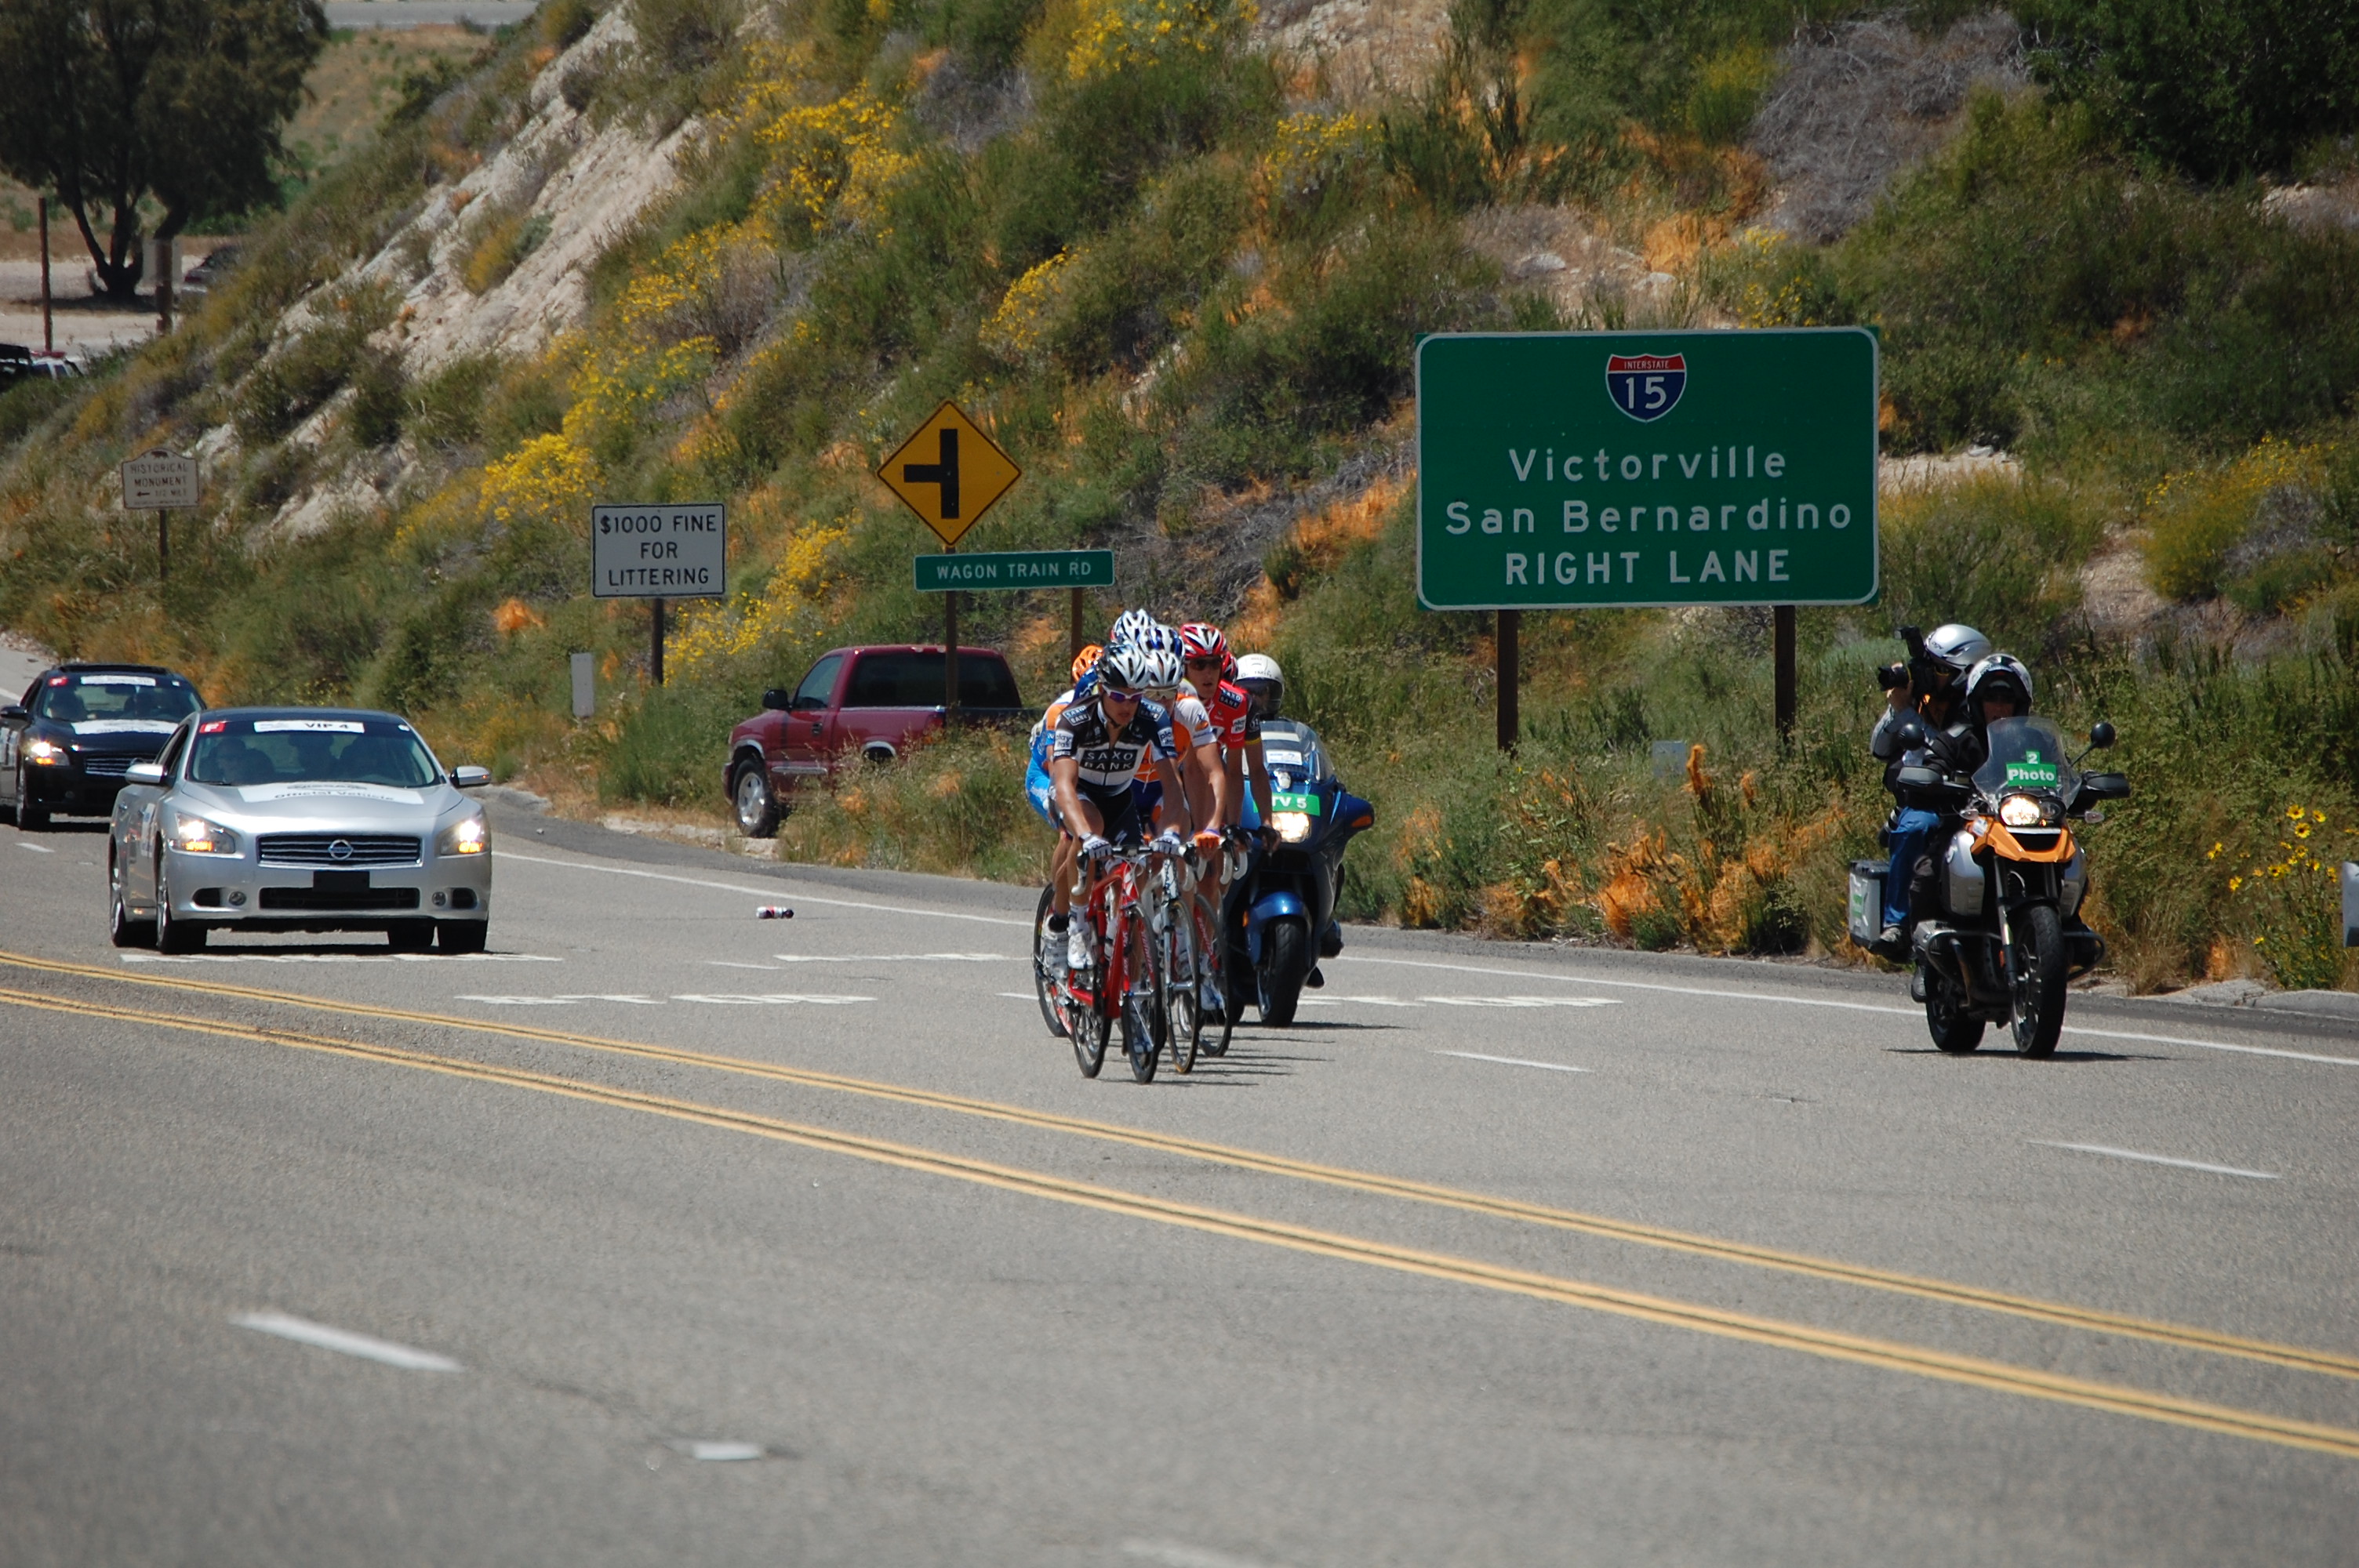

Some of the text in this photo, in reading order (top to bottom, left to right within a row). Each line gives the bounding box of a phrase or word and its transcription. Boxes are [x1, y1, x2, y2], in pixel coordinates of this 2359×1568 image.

[1624, 360, 1669, 369] INTERSTATE
[1626, 376, 1667, 409] 15
[130, 463, 188, 474] HISTORICAL
[1508, 445, 1786, 482] Victorville
[135, 476, 187, 487] MONUMENT
[1445, 497, 1851, 535] San Bernardino
[600, 514, 717, 535] $1000 FINE
[641, 542, 678, 559] FOR
[936, 561, 1092, 579] WAGON TRAIN RD
[1506, 550, 1790, 585] RIGHT LANE
[609, 567, 709, 586] LITTERING
[1087, 751, 1133, 760] SAXO
[2028, 753, 2038, 764] 2
[1084, 761, 1132, 771] BANK
[2008, 768, 2055, 782] Photo
[1271, 797, 1307, 809] TV 5
